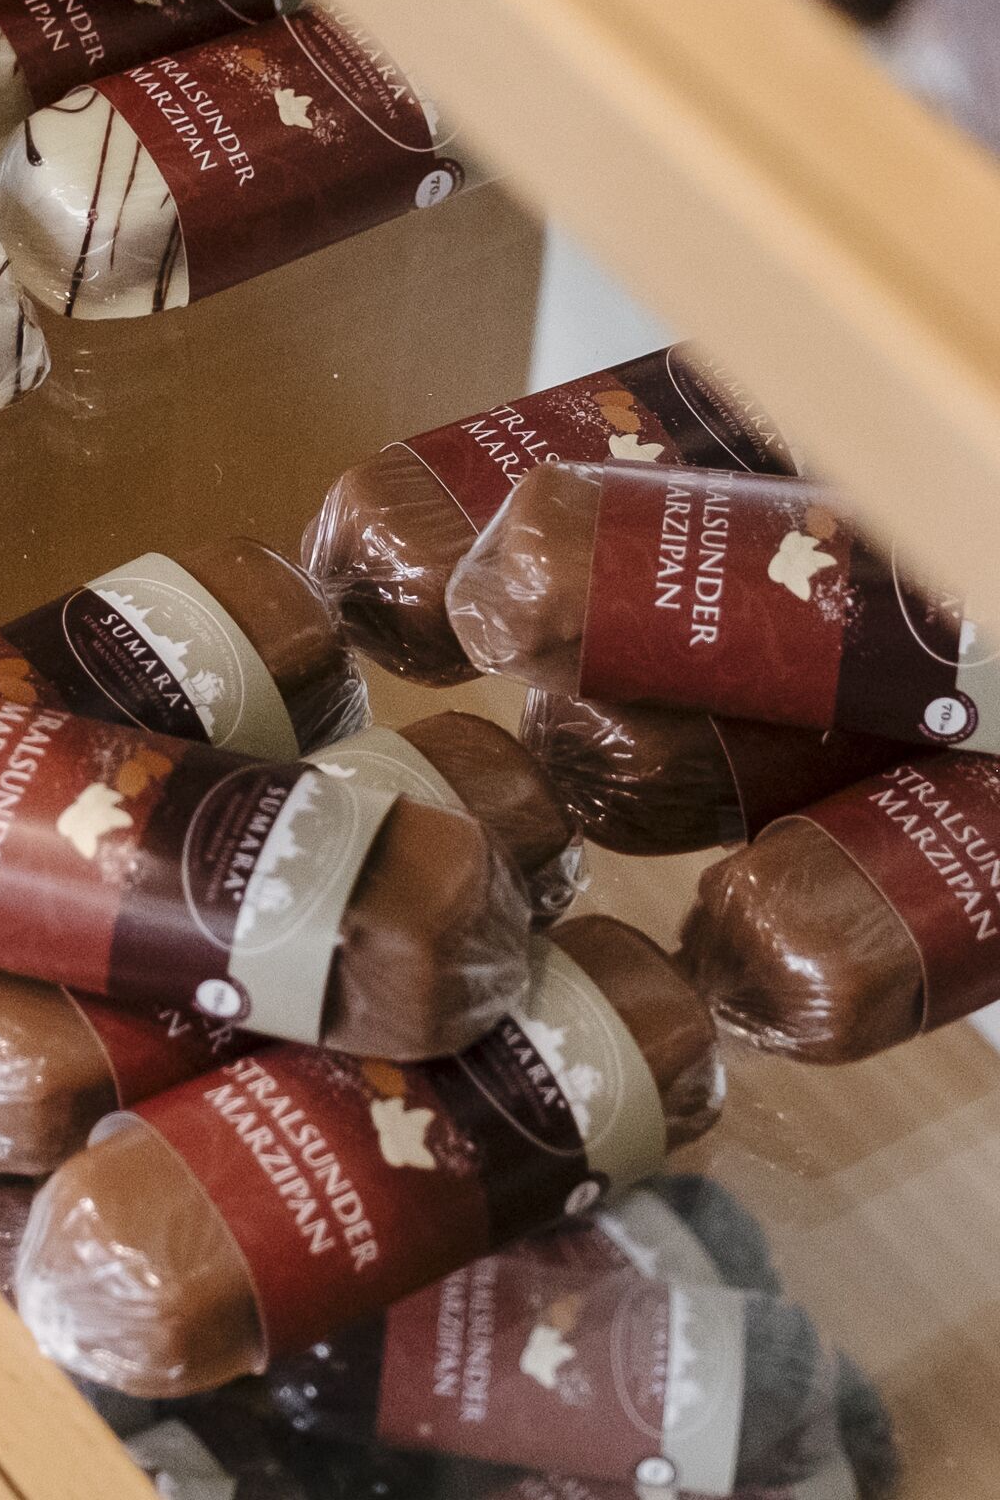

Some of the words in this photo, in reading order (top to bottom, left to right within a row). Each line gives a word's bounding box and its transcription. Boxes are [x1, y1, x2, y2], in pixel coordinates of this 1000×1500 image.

[123, 66, 218, 171] MARZIPAN
[654, 469, 697, 610] MARZIPAN
[100, 613, 182, 708] SUMARA
[223, 784, 287, 890] SUMARA
[868, 788, 998, 941] MARZIPAN
[203, 1084, 336, 1256] MARZIPAN
